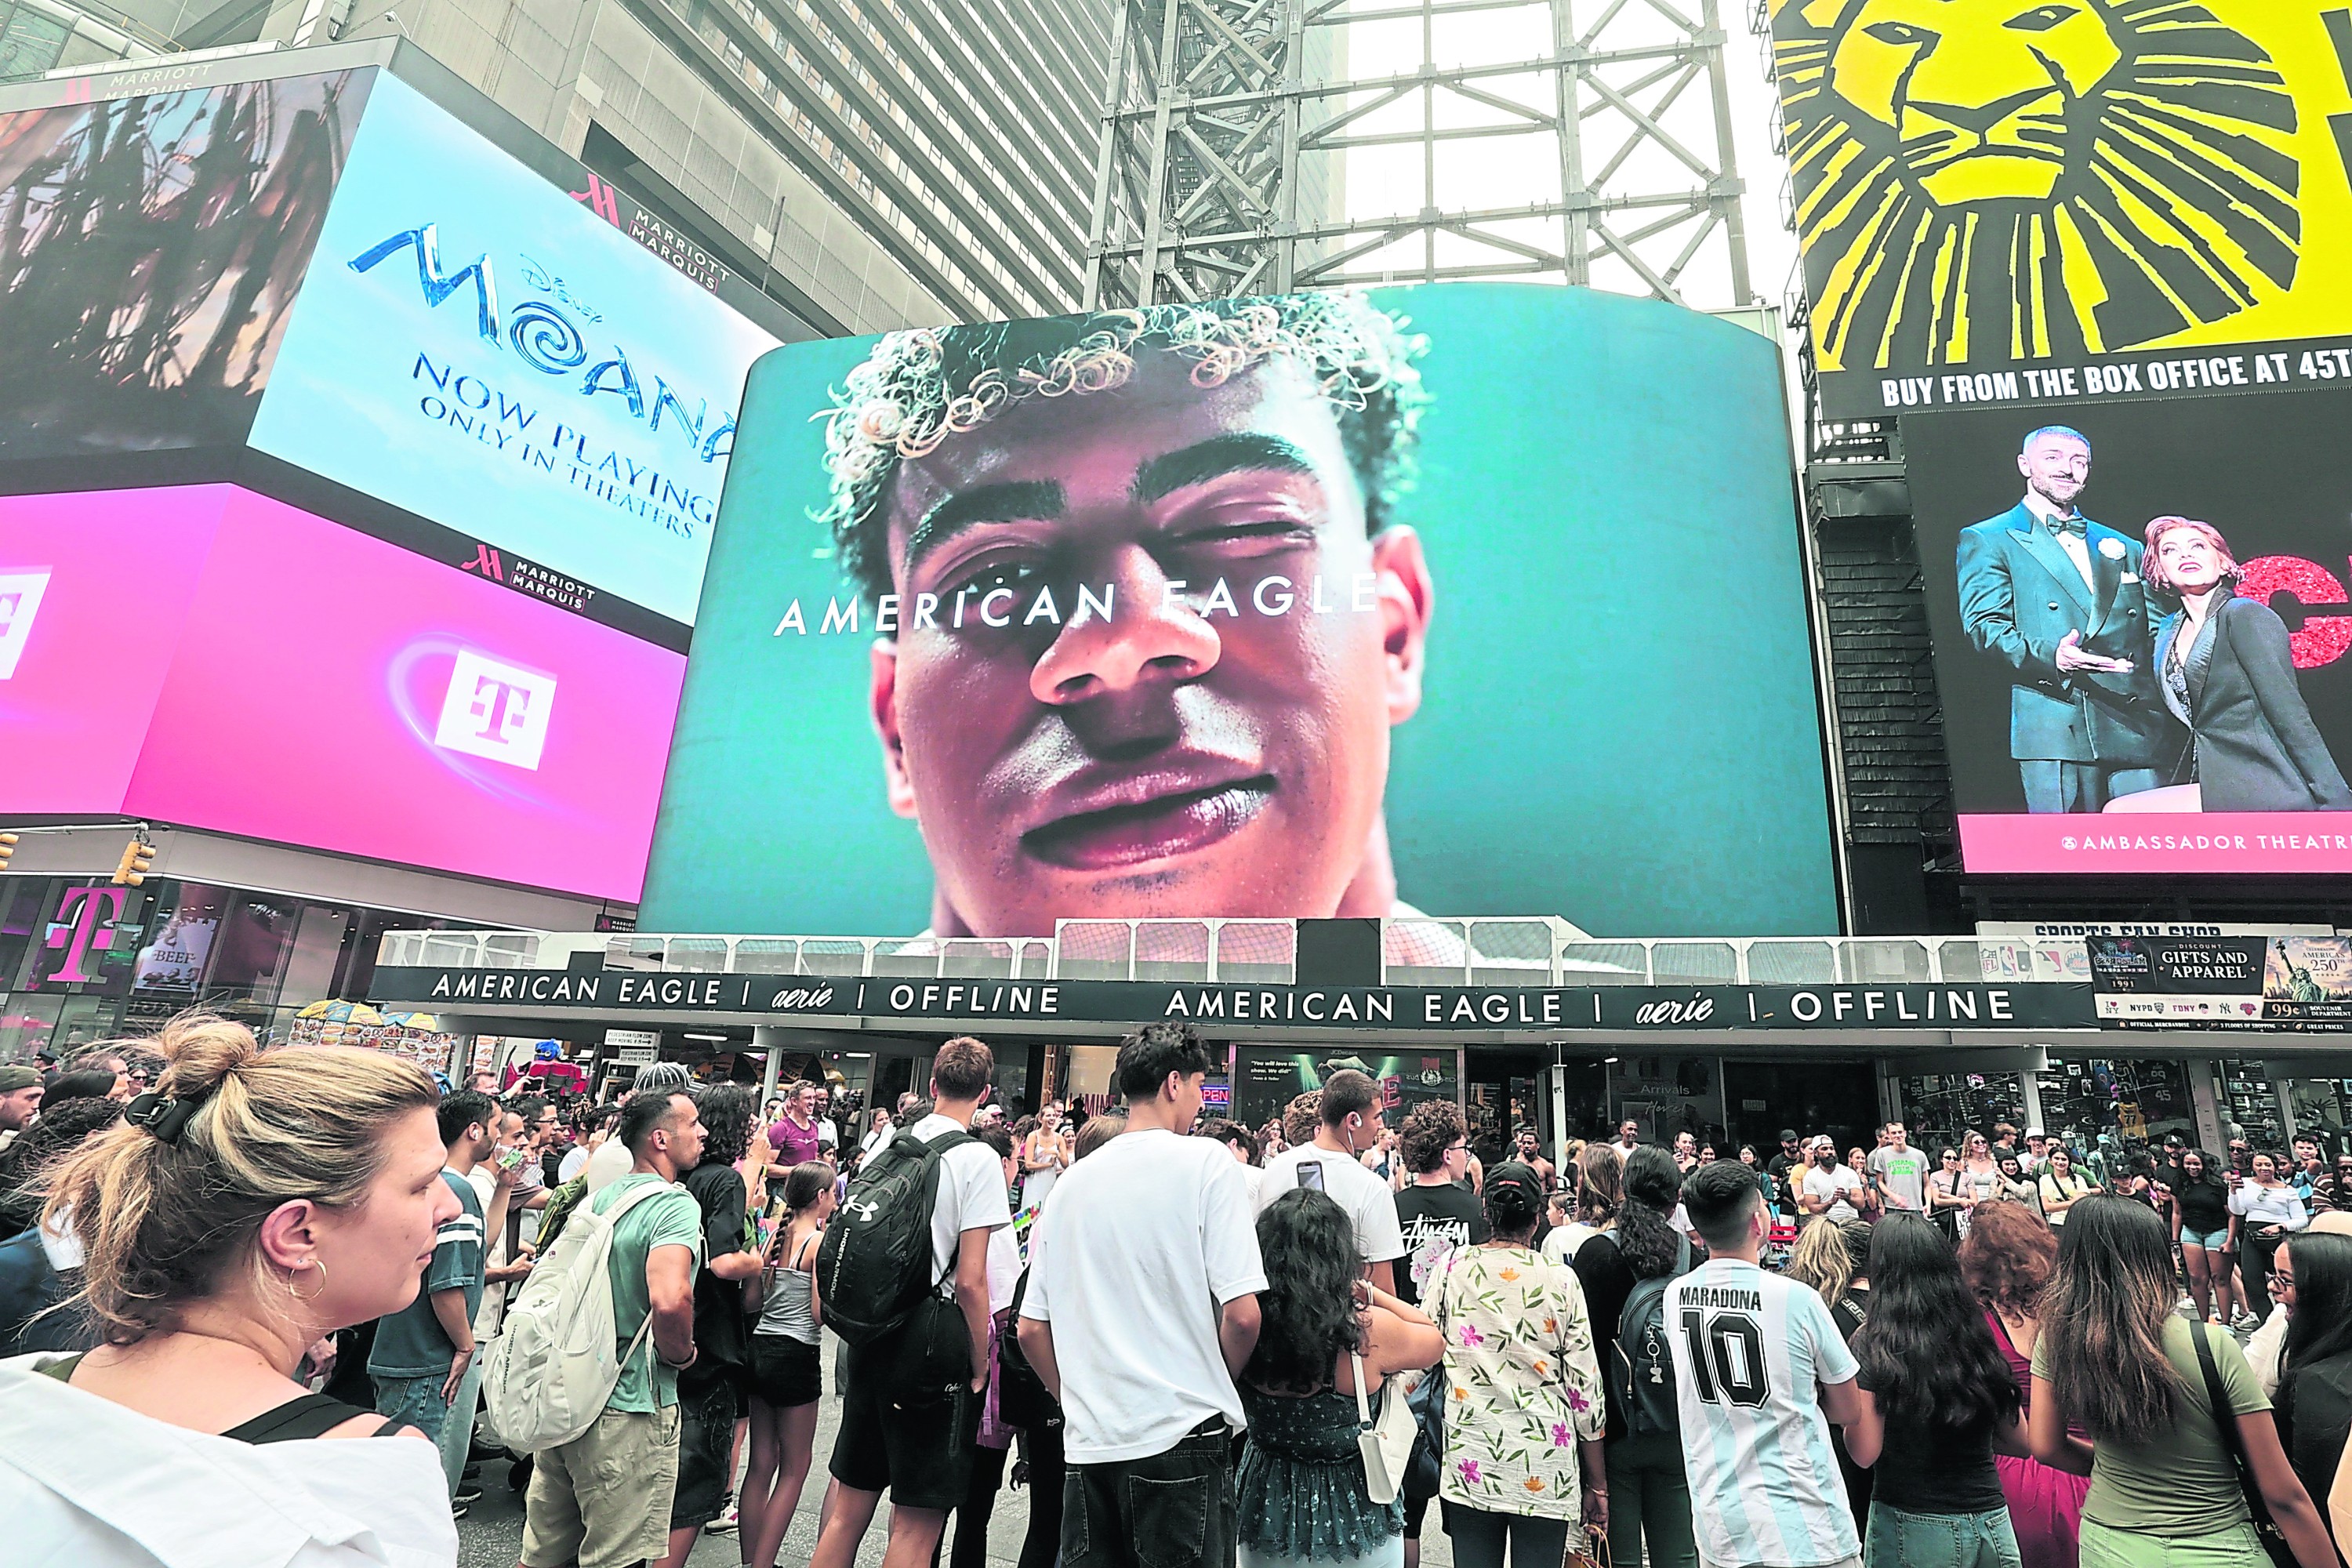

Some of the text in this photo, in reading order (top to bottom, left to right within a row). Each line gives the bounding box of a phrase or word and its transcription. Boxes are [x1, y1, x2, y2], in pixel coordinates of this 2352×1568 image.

[110, 64, 213, 87] MARRIOTT
[631, 225, 715, 289] MARQUIS
[635, 210, 730, 281] MARRIOTT
[1881, 347, 2352, 407] BUY FROM THE BOX OFFICE AT 45T
[412, 351, 714, 524] NOW PLAYING
[420, 395, 695, 540] ONLY IN THEATERS
[512, 574, 583, 609] MARQUIS
[515, 561, 596, 600] MARRIOTT
[773, 572, 1377, 637] AMERICAN EAGLE
[2082, 835, 2352, 850] AMBASSADOR THEATR
[2161, 951, 2248, 964] GIFTS AND
[2171, 966, 2247, 978] APPAREL
[430, 974, 1058, 1013] AMERICAN EAGLE aerie OFFLINE
[1163, 990, 2015, 1025] AMERICAN EAGLE aerie OFFLINE
[2130, 1004, 2153, 1012] NYPD
[1201, 1090, 1229, 1102] PEN
[1640, 1084, 1690, 1095] Arrivals
[2155, 1089, 2171, 1102] 45
[2124, 1115, 2136, 1124] 77
[829, 1227, 851, 1301] UNDER ARMOUR
[1679, 1287, 1762, 1312] MARADONA
[507, 1324, 517, 1355] UNDER
[1679, 1308, 1772, 1410] 10
